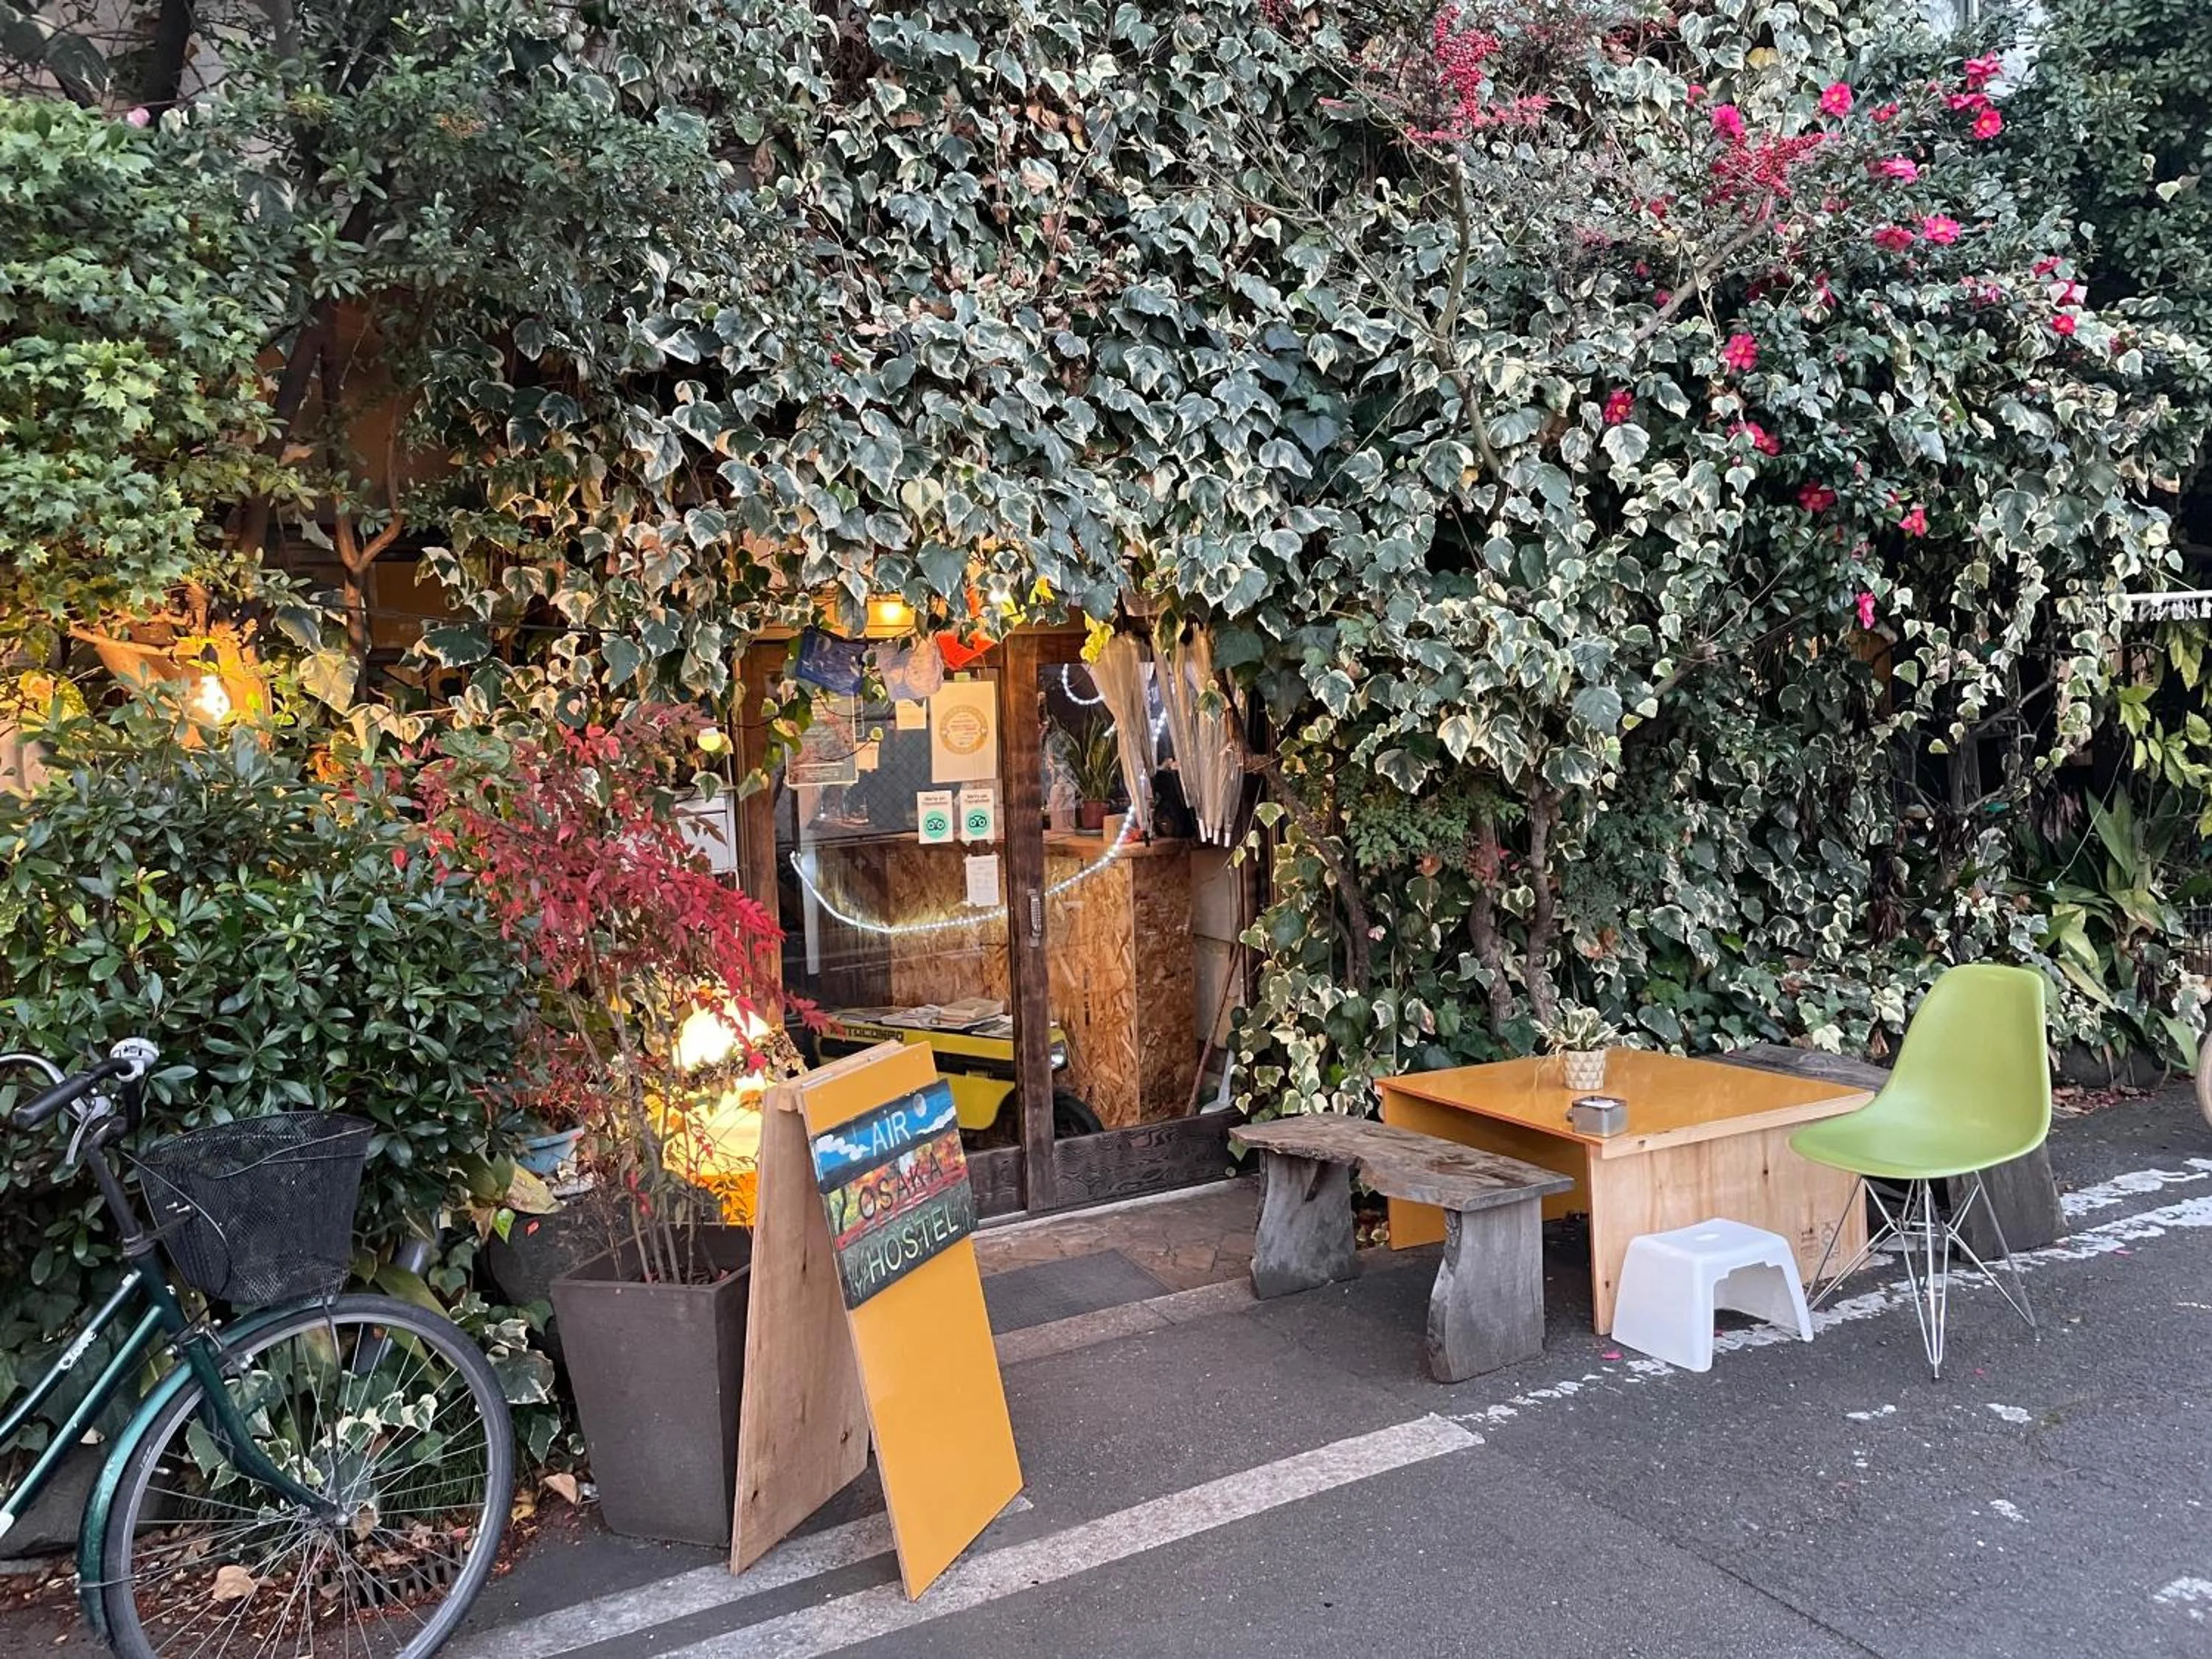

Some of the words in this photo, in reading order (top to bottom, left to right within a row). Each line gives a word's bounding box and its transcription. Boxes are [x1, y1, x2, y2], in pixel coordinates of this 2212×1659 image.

[872, 1110, 911, 1157] AIR
[859, 1152, 944, 1219] OSAKA
[866, 1203, 959, 1284] HOSTEL
